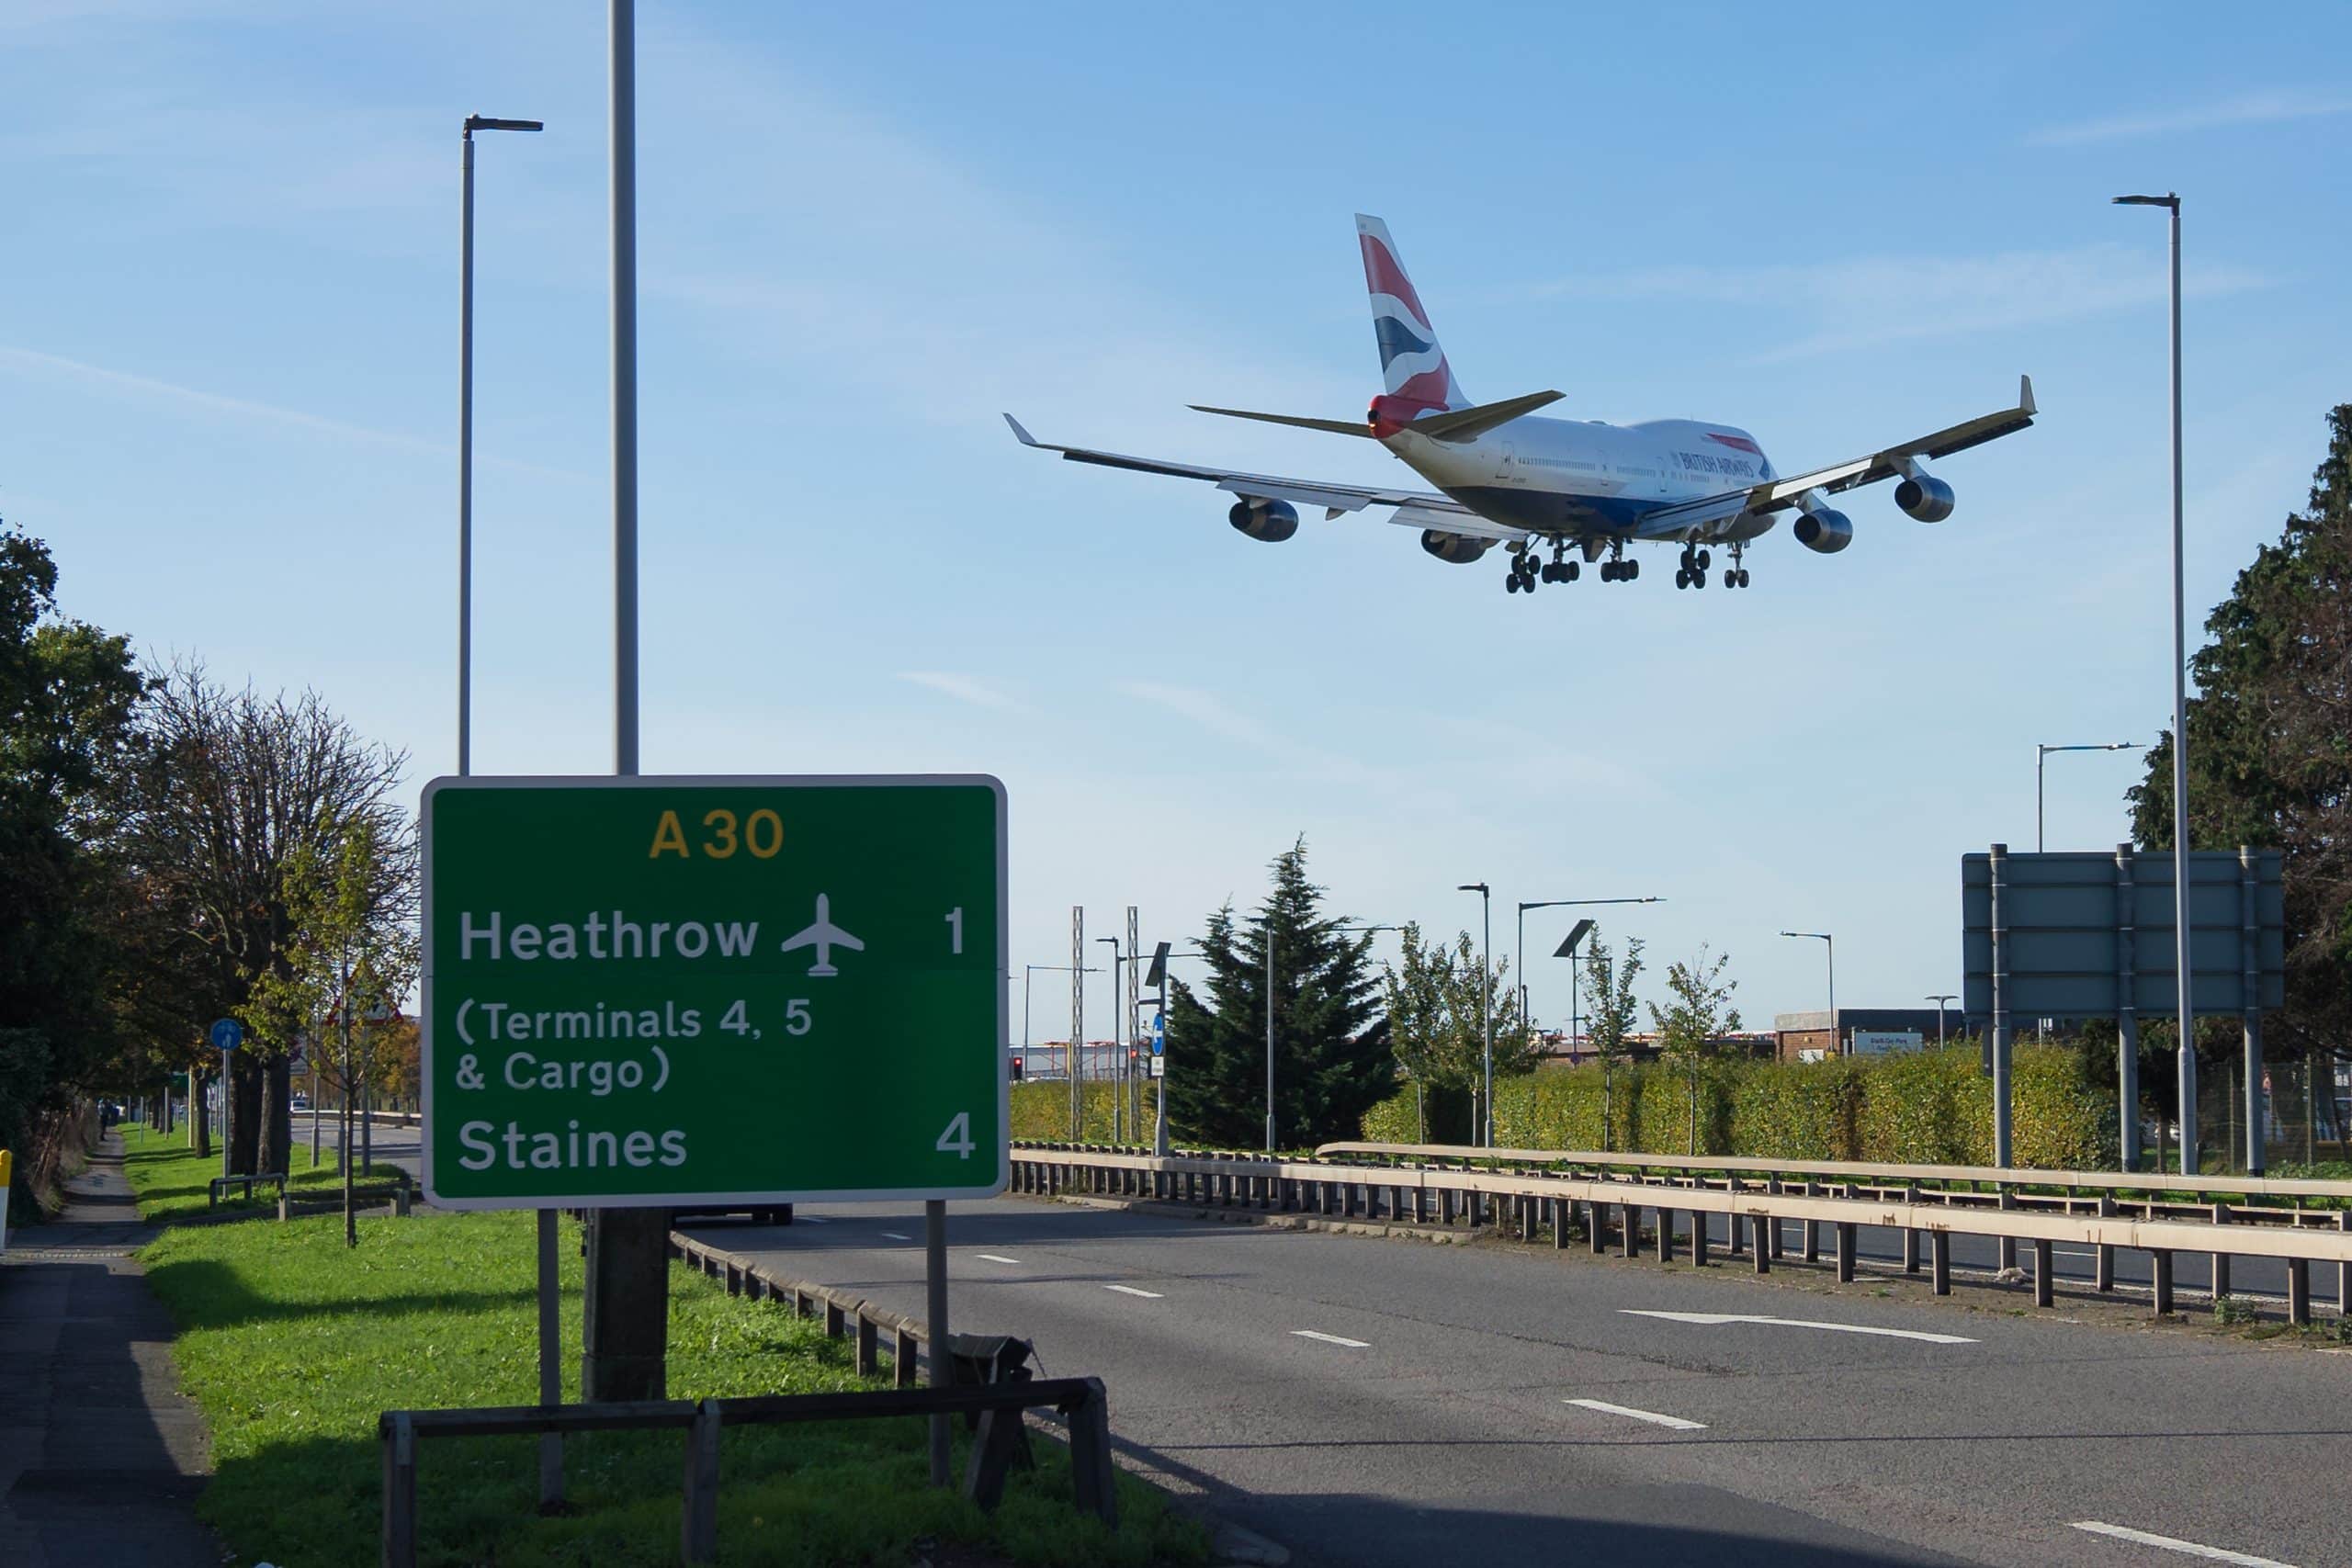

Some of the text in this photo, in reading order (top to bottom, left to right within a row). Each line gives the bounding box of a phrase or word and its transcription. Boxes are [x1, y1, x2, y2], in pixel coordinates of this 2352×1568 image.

[1679, 451, 1754, 478] BRITISH AIRWAYS
[462, 910, 759, 960] Heathrow
[945, 907, 962, 953] 1
[457, 998, 812, 1045] (Terminals 4, 5
[456, 1045, 670, 1096] & Cargo)
[459, 1120, 687, 1170] Staines
[936, 1112, 976, 1158] 4
